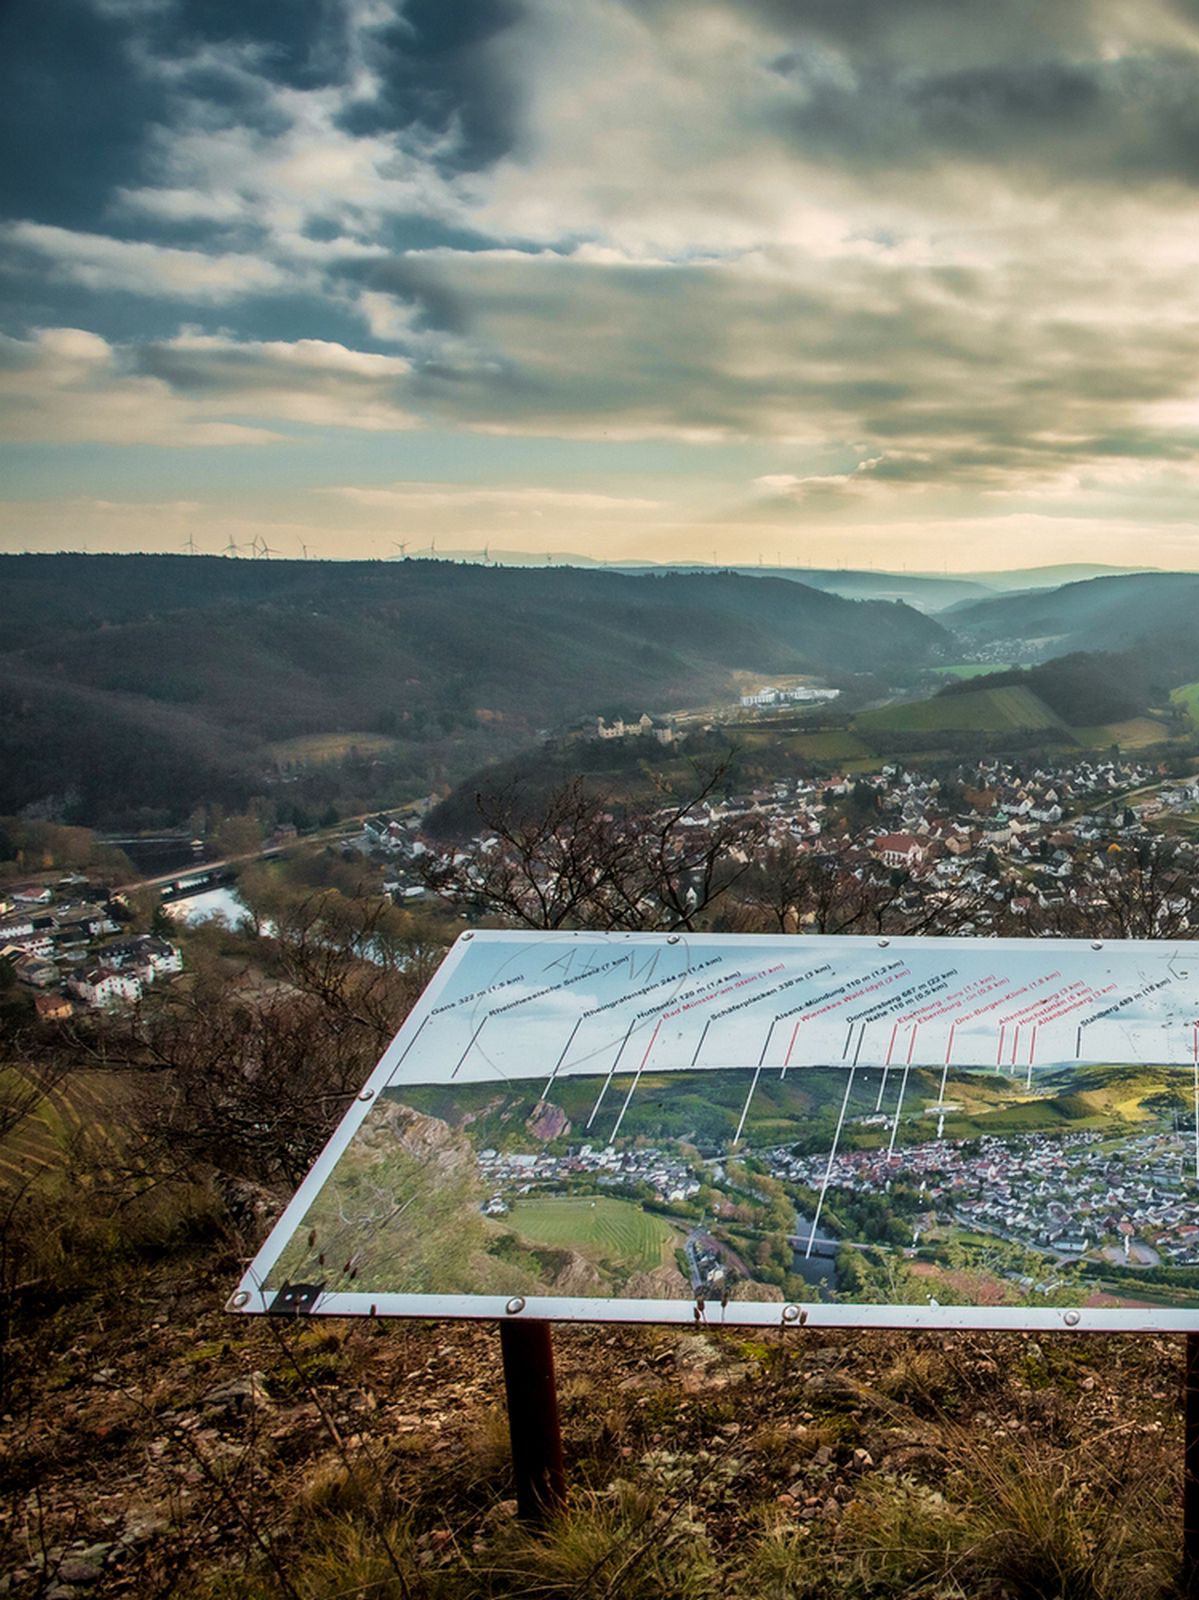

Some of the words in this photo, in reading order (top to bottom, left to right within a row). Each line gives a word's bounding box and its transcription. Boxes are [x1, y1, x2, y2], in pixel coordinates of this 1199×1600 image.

[724, 971, 741, 981] km)
[814, 964, 831, 974] km)
[888, 960, 904, 970] km)
[894, 969, 911, 979] km)
[1044, 971, 1061, 981] km)
[431, 1003, 456, 1015] Gans
[506, 975, 524, 985] km)
[489, 984, 561, 1016] Rheinhessische
[564, 968, 599, 986] Schweiz
[583, 984, 658, 1018] Rheingrafenstein
[705, 956, 722, 966] km)
[662, 1008, 681, 1019] Bad
[720, 986, 733, 995] am
[734, 976, 757, 988] Stein
[768, 964, 785, 974] km)
[846, 996, 901, 1024] Donnersberg
[941, 969, 958, 979] km)
[866, 1011, 888, 1023] Nahe
[930, 982, 948, 992] km)
[897, 1001, 942, 1023] Ebernburg
[917, 1001, 962, 1024] Ebernburg
